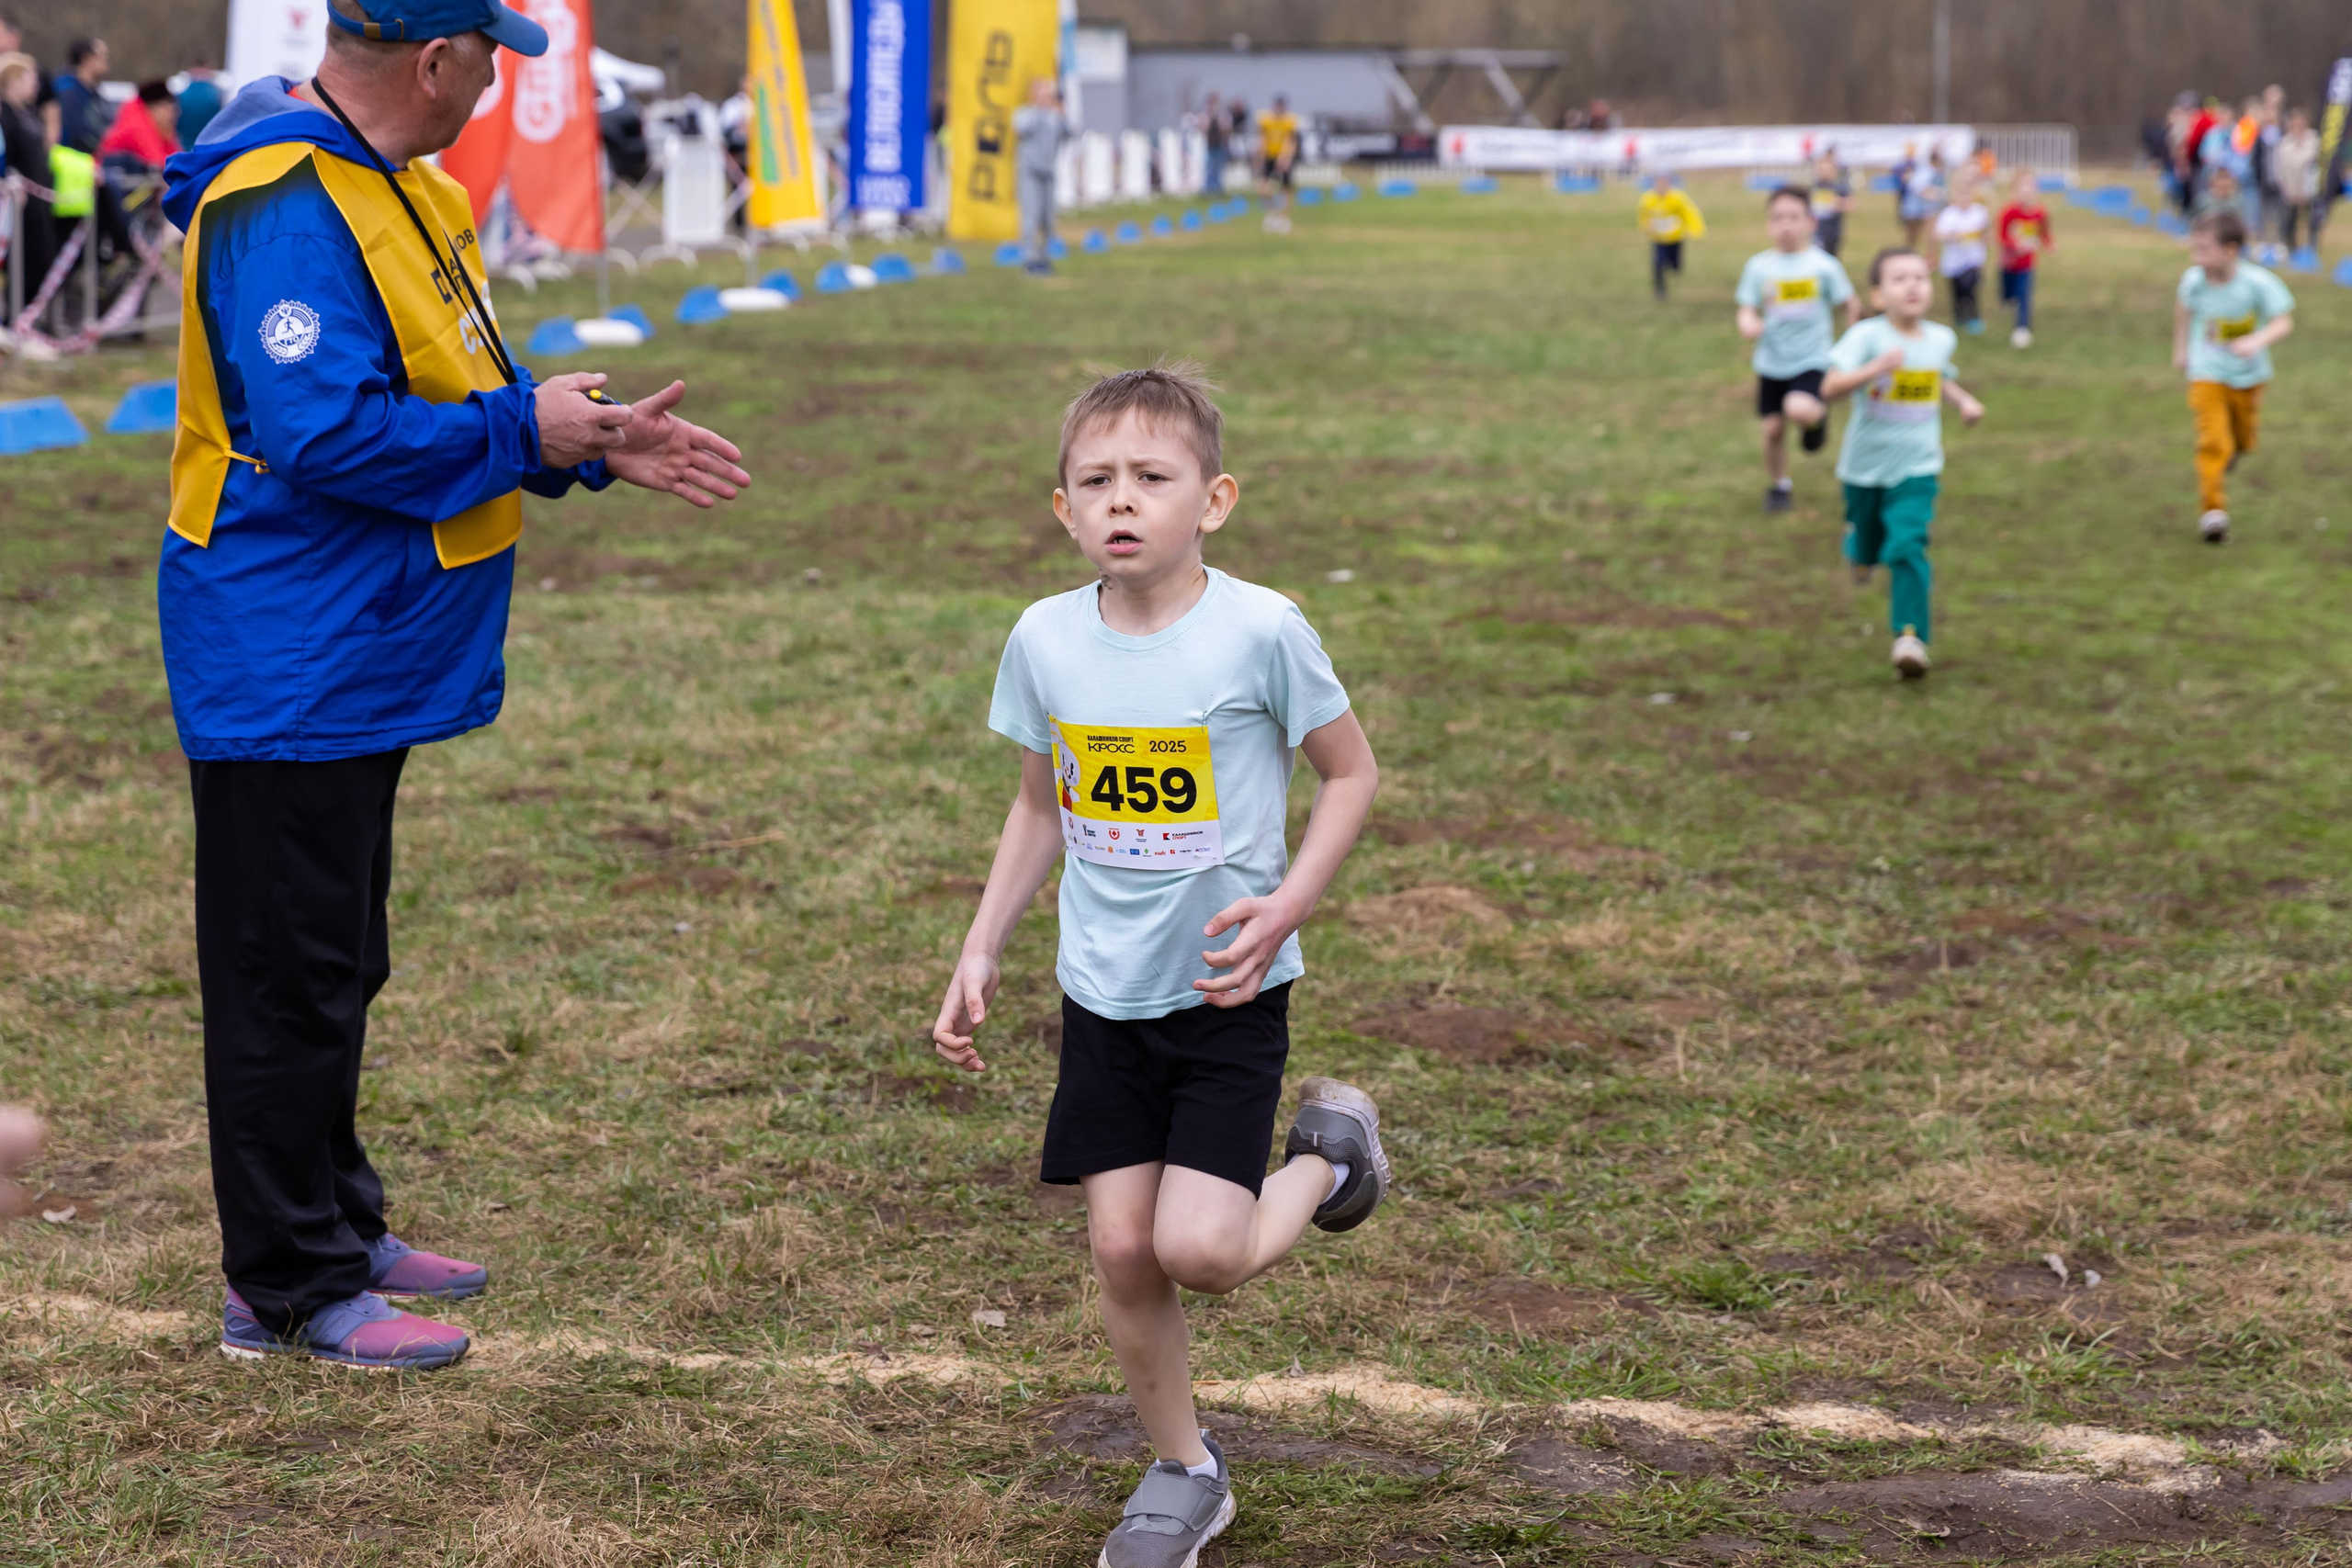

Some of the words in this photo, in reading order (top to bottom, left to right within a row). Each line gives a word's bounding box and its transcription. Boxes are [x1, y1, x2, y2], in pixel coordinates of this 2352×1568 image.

[1088, 742, 1136, 753] КРОСС
[1148, 739, 1187, 753] 2025
[1091, 765, 1197, 814] 459
